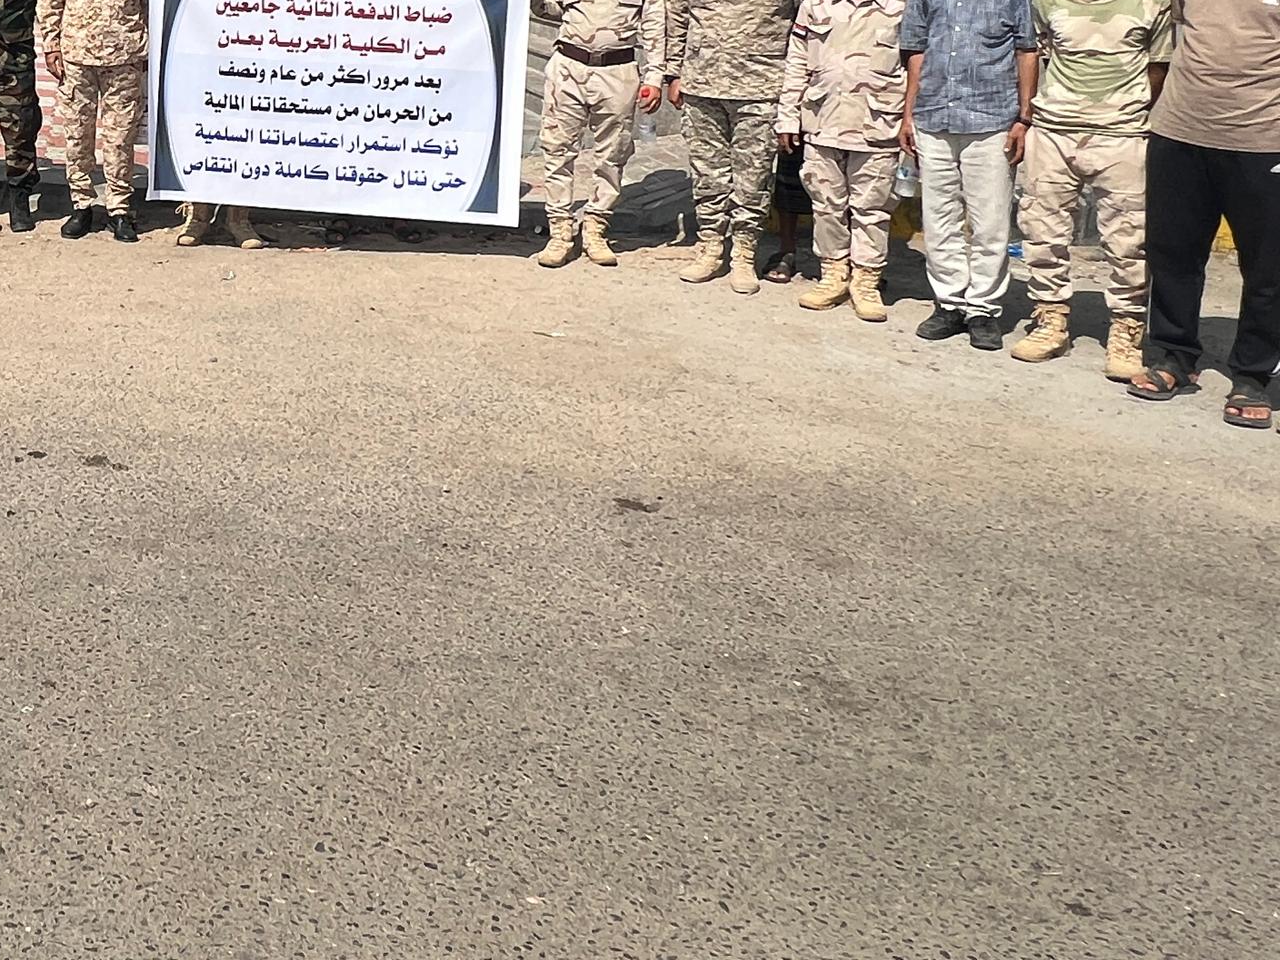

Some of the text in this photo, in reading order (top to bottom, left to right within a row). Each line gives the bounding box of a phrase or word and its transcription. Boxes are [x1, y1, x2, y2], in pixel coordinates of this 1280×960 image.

[343, 1, 399, 20] الدفعة
[403, 6, 452, 28] ضباط
[217, 29, 445, 60] من الكلية الحربية بعدن
[218, 61, 441, 94] بعد مرور اكثر من عام ونصف
[203, 91, 452, 127] من الحرمان من مستحقاتنا المالية
[194, 123, 458, 159] نؤكد استمرار اعتصاماتنا السلمية
[182, 156, 466, 192] حتى ننال حقوقنا كاملة دون انتقاص
